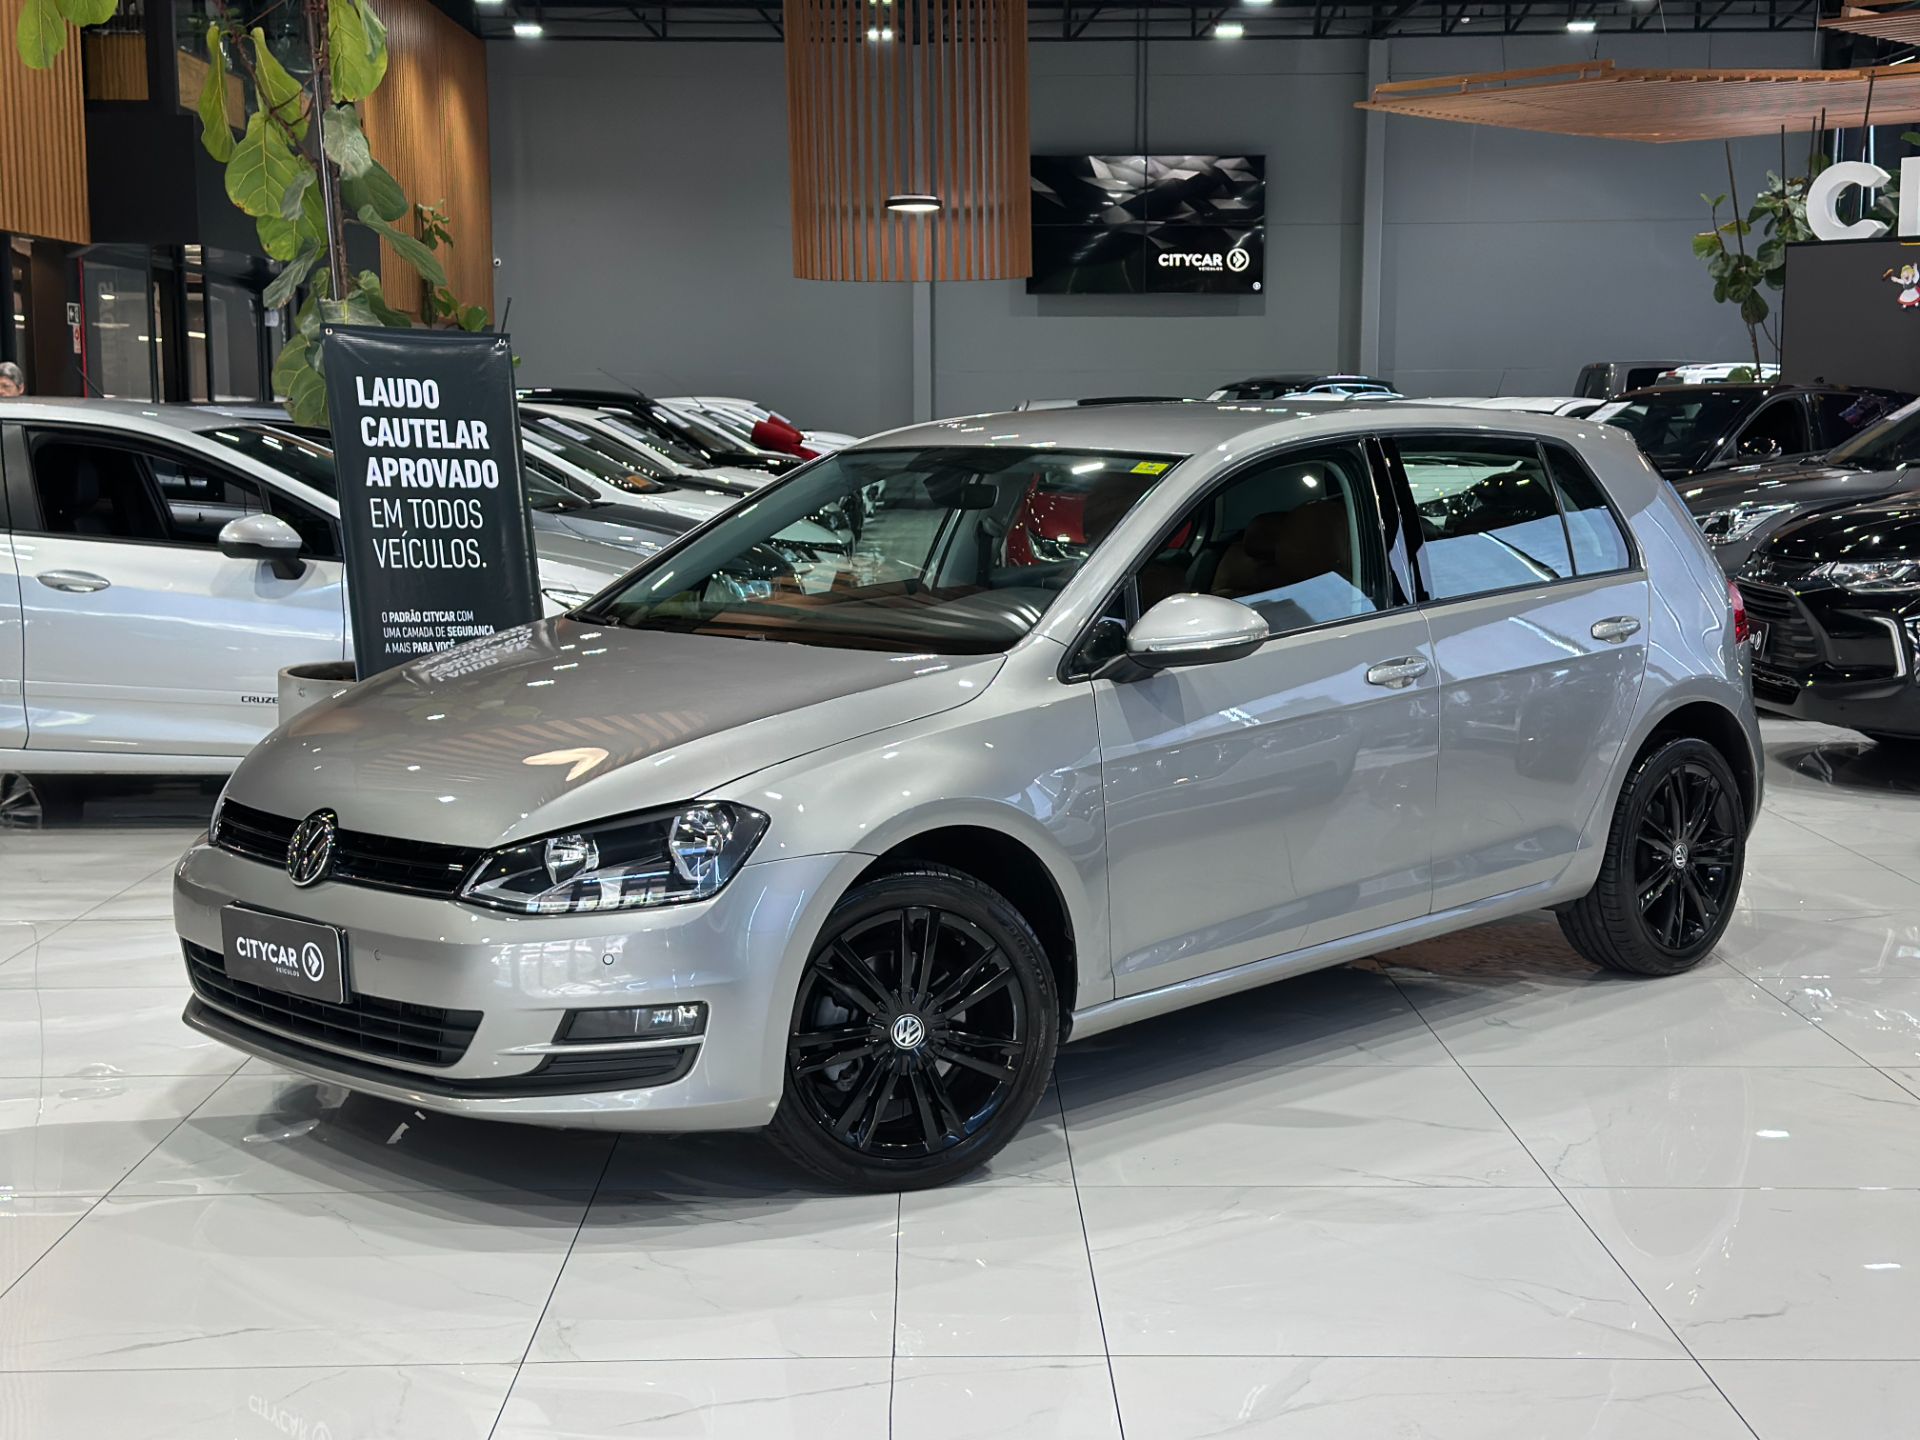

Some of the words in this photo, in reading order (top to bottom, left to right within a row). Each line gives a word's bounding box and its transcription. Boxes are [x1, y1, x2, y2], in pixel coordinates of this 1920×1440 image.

[1158, 253, 1223, 267] CITYCAR
[355, 376, 440, 410] LAUDO
[360, 416, 490, 450] CAUTELAR
[365, 457, 499, 489] APROVADO
[369, 498, 403, 528] EM
[407, 498, 484, 529] TODOS
[372, 530, 487, 569] VEÍCULOS.
[381, 611, 388, 623] O
[389, 609, 421, 622] PADRÃO
[422, 611, 456, 622] CITYCAR
[456, 610, 474, 621] COM
[383, 627, 402, 639] UMA
[402, 626, 434, 638] CAMADA
[435, 626, 446, 637] DE
[385, 642, 392, 653] A
[392, 641, 412, 653] MAIS
[412, 641, 434, 653] PARA
[241, 695, 278, 704] CRUZE
[236, 936, 299, 969] CITYCAR
